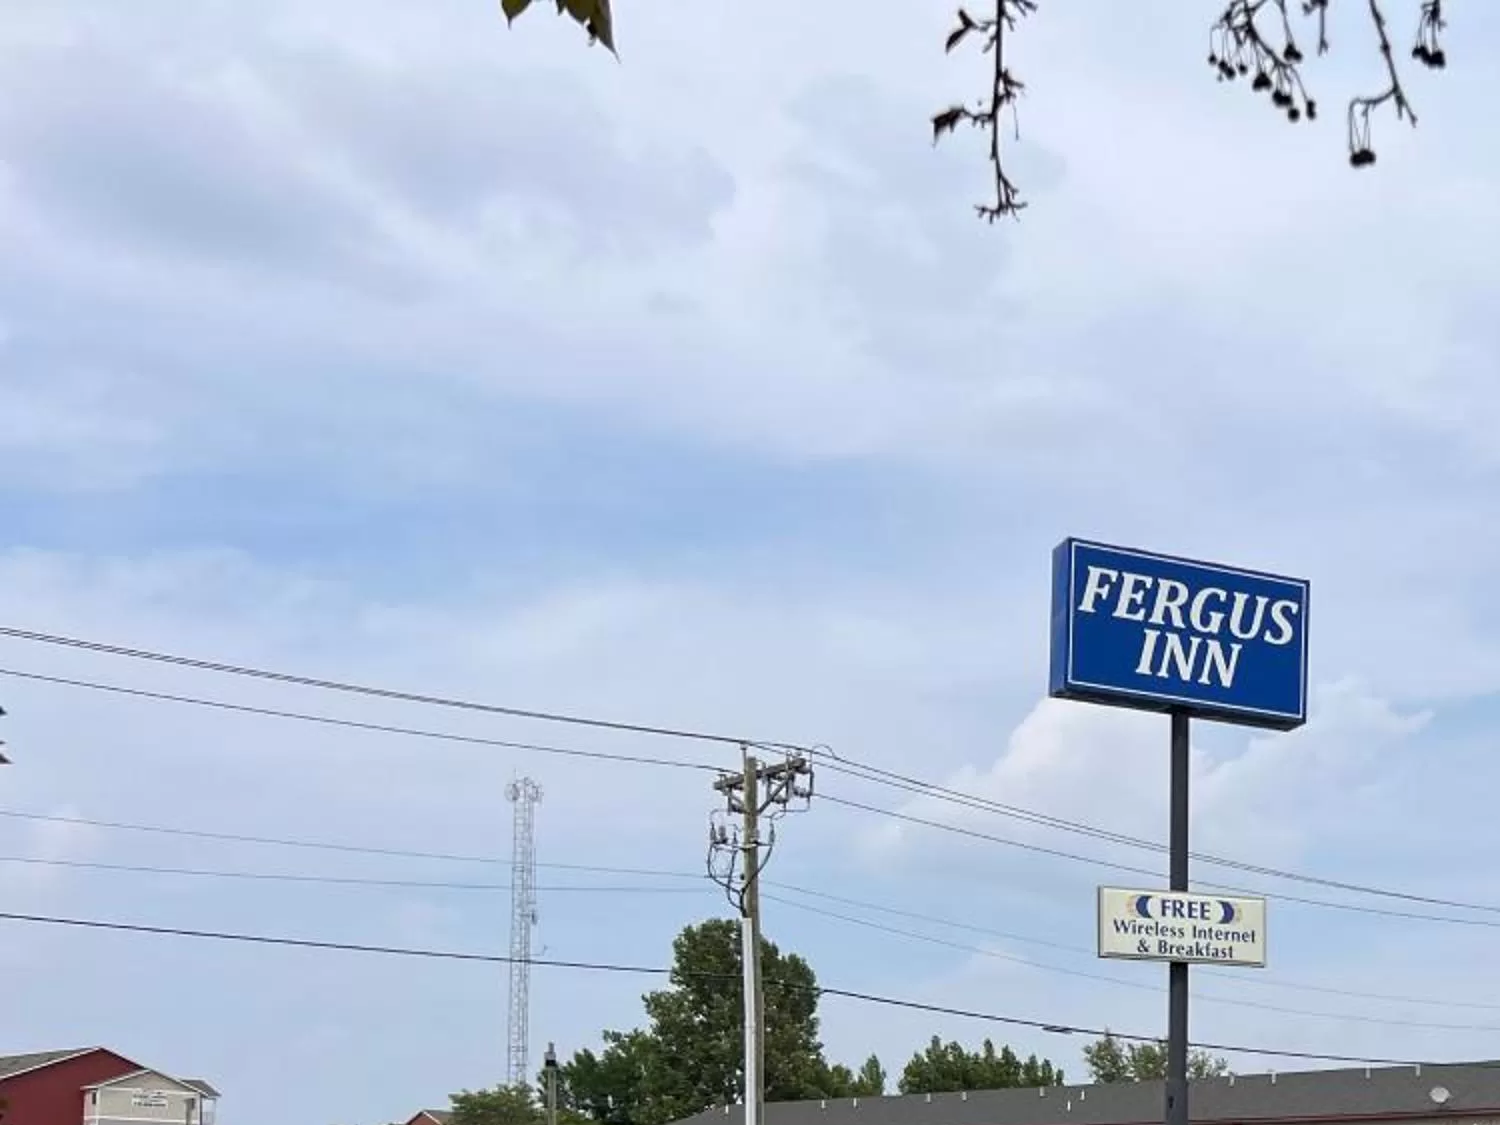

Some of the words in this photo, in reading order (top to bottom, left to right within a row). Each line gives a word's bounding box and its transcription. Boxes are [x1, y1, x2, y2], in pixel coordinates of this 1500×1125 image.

[1077, 565, 1298, 645] FERGUS
[1135, 628, 1243, 689] INN
[1161, 899, 1211, 921] FREE
[1113, 918, 1185, 938] Wireless
[1192, 925, 1256, 944] Internet
[1137, 938, 1150, 953] &
[1158, 939, 1234, 959] Breakfast
